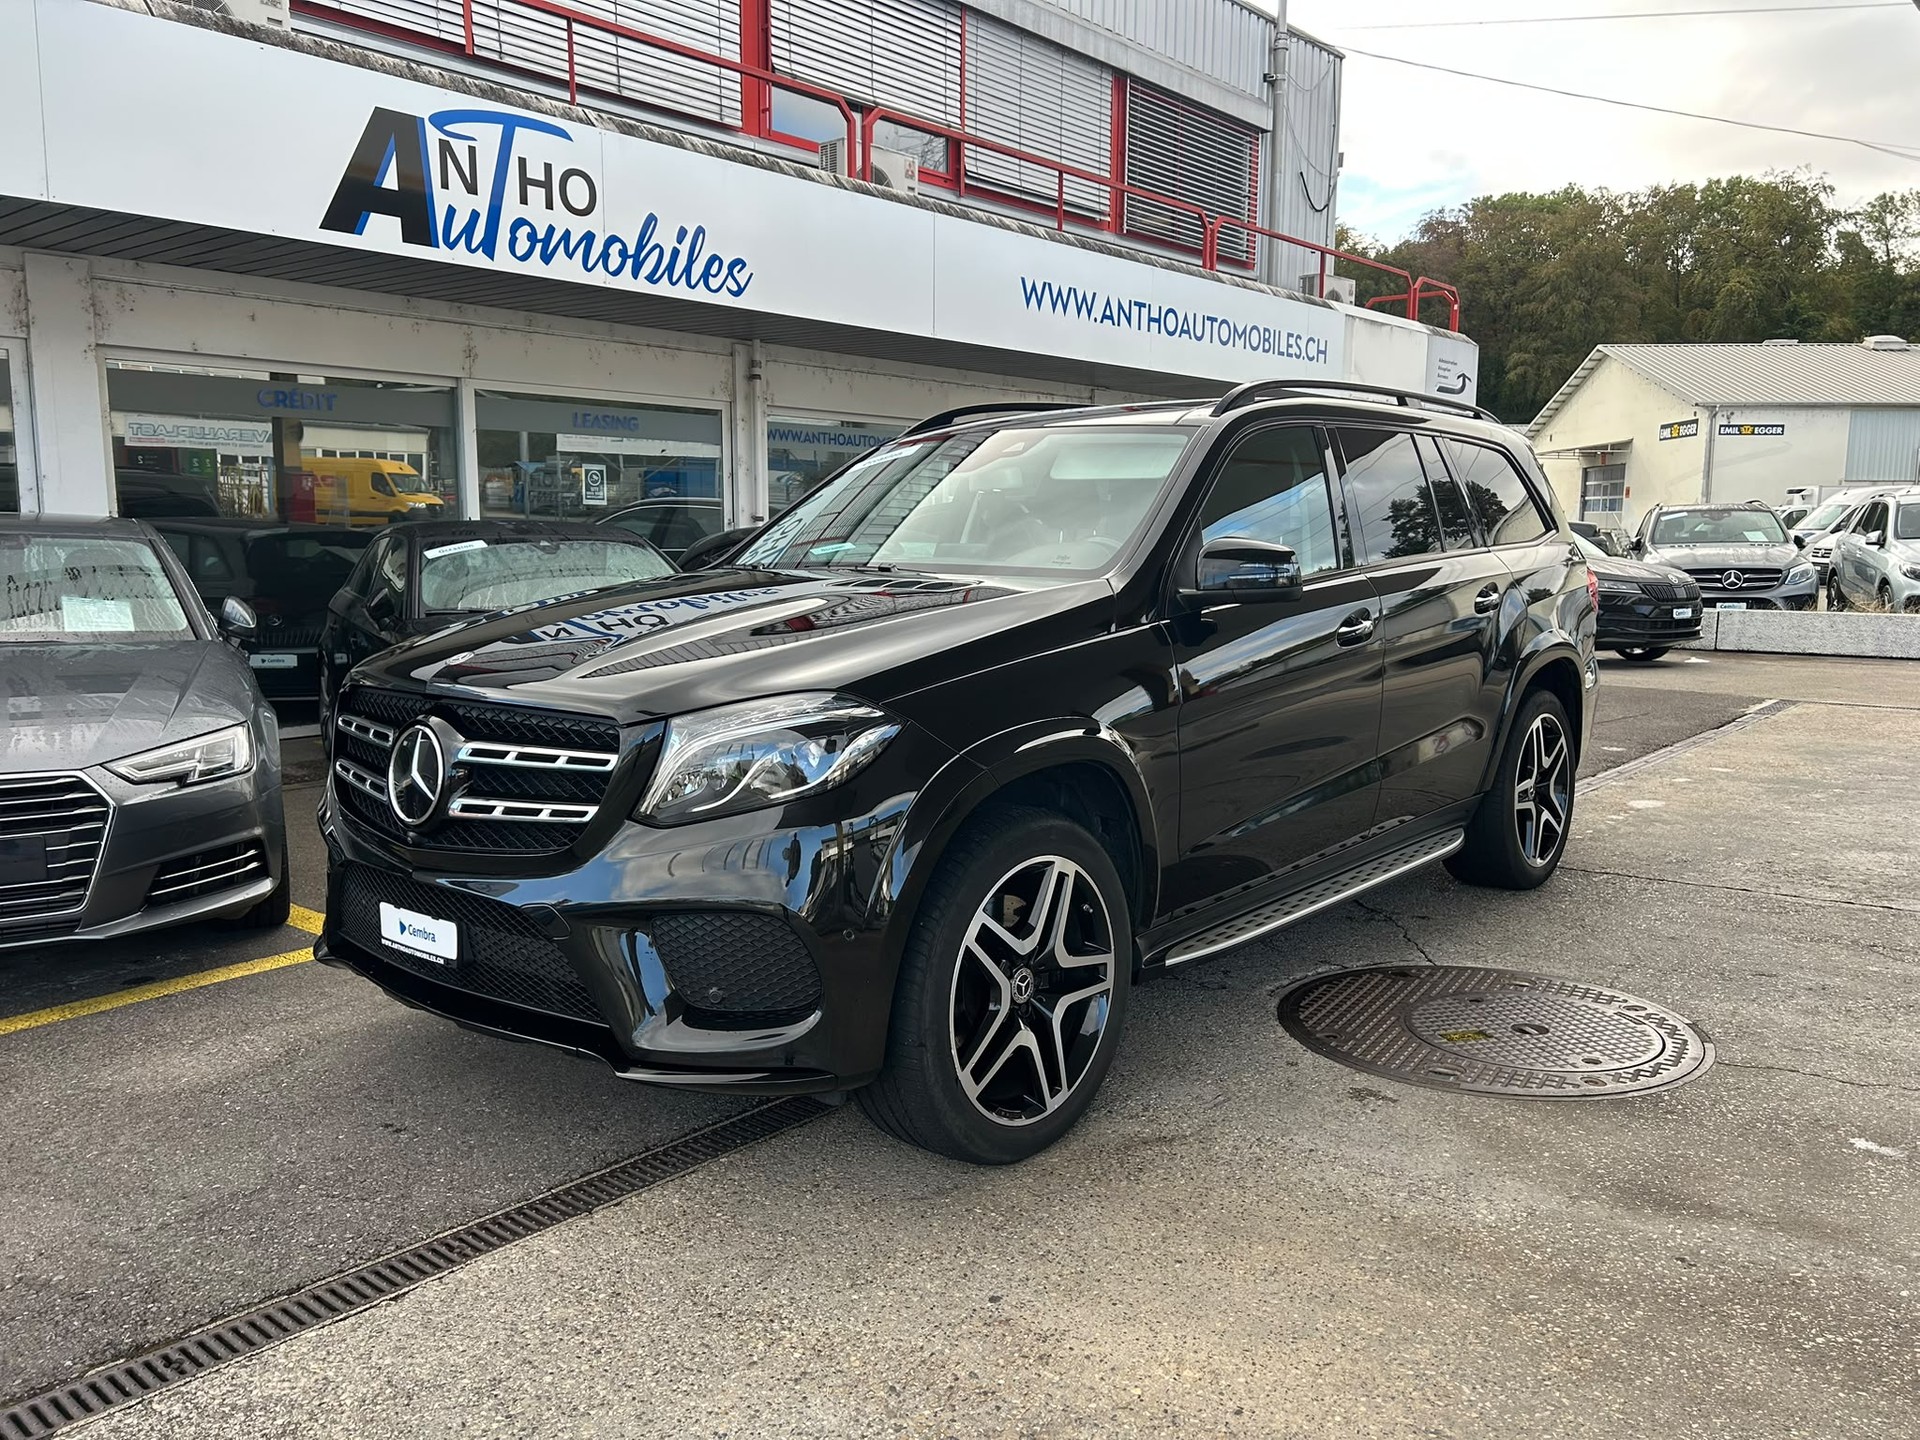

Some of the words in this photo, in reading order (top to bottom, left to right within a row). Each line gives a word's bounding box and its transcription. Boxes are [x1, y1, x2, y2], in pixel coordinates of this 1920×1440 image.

[319, 106, 598, 262] ANTHO
[1021, 276, 1328, 364] WWW.ANTHOAUTOMOBILES.CH
[257, 388, 338, 411] CRÉDIT
[573, 412, 639, 432] LEASING
[1680, 423, 1697, 436] EGGER
[1720, 425, 1740, 434] EMIL
[1754, 425, 1783, 435] EGGER
[407, 923, 437, 943] Cembra
